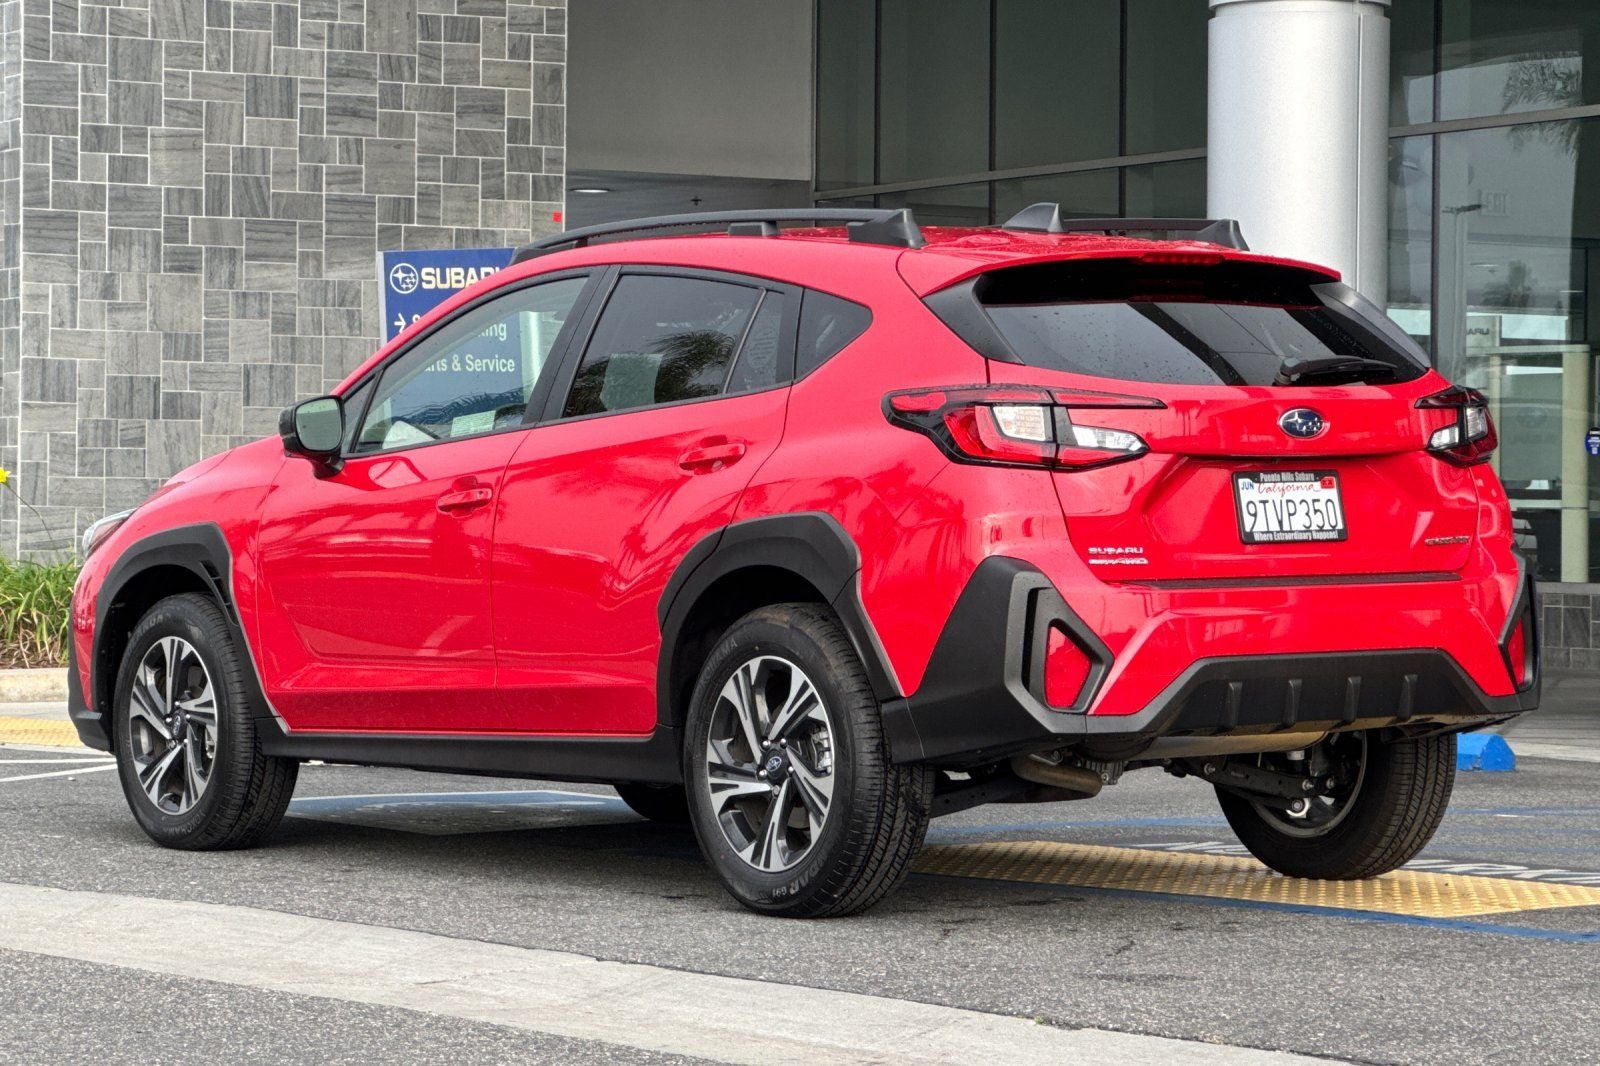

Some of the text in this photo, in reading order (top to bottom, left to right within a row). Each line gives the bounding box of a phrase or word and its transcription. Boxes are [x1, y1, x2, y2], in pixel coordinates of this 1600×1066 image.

[421, 267, 500, 289] SUBA
[452, 354, 461, 372] &
[465, 354, 515, 372] Service
[1241, 481, 1254, 490] JUN
[1258, 482, 1321, 498] California
[1246, 498, 1338, 532] 9TVP350
[1254, 531, 1273, 541] Where
[1088, 546, 1144, 554] SUBARU
